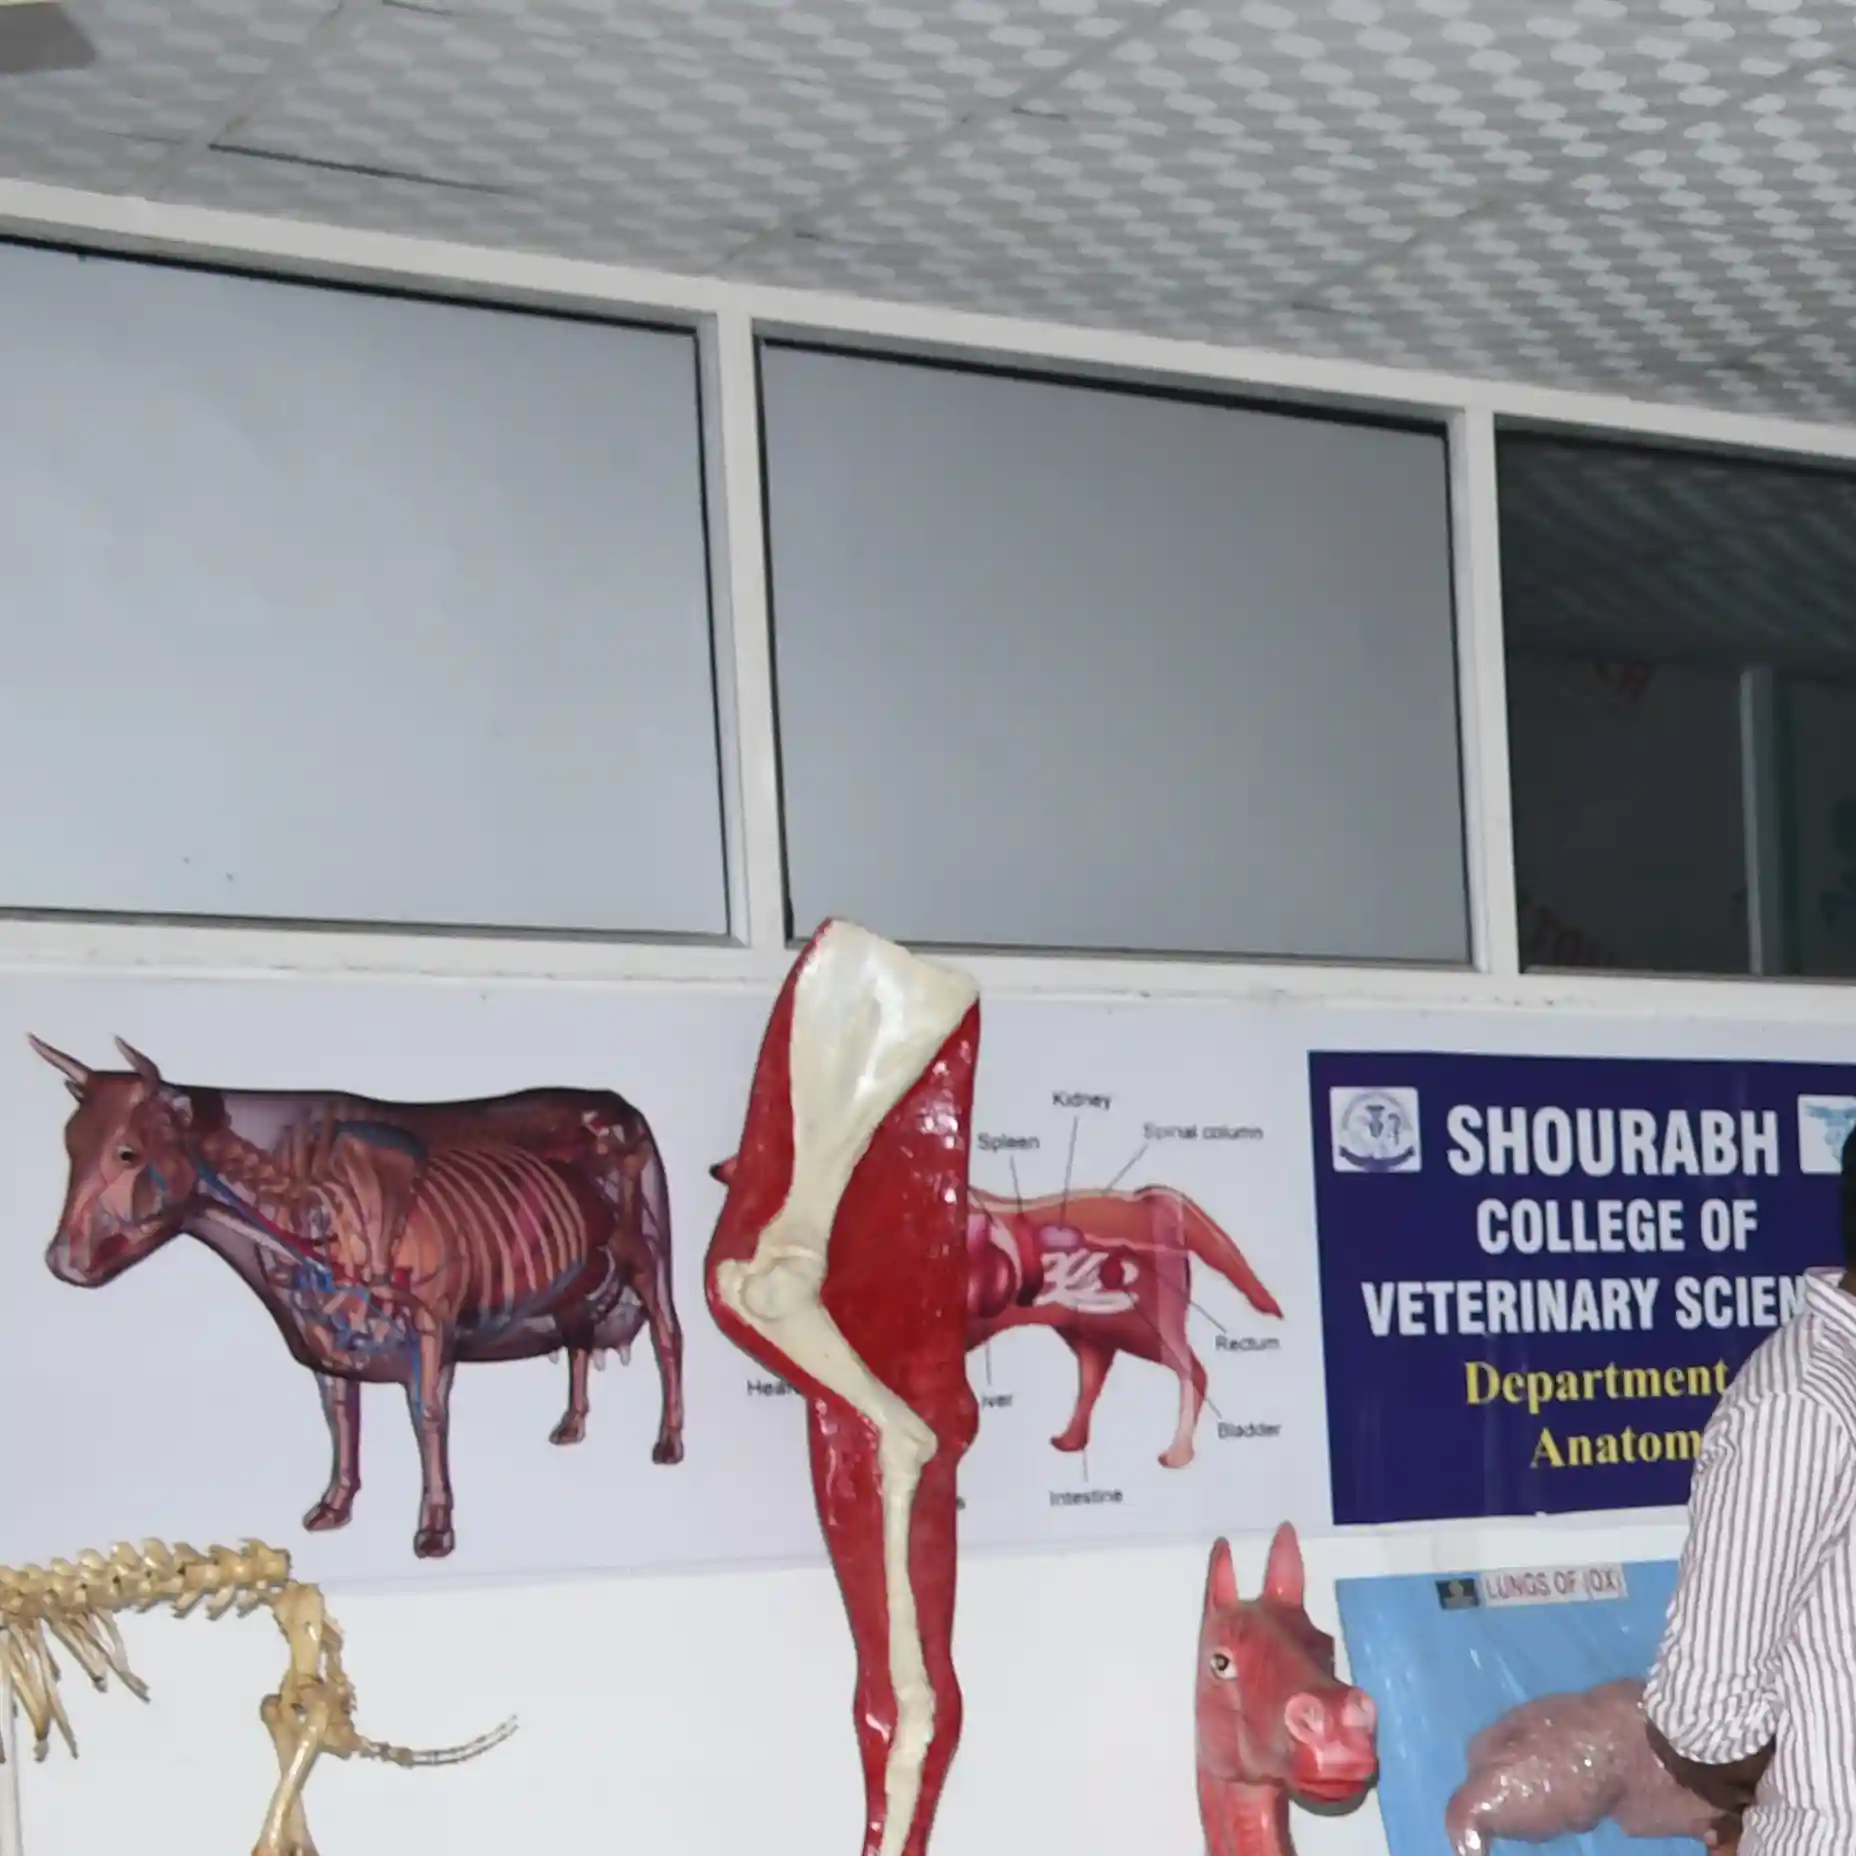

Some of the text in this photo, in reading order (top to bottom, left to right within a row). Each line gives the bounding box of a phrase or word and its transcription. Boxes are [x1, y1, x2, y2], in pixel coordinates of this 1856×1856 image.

[1052, 1090, 1112, 1110] Kidney
[1447, 1105, 1779, 1177] SHOURABH
[1476, 1198, 1757, 1254] COLLEGE OF
[1361, 1275, 1806, 1336] VETERINARY SCIEN
[1464, 1357, 1728, 1413] Department
[1530, 1423, 1702, 1468] Anatom
